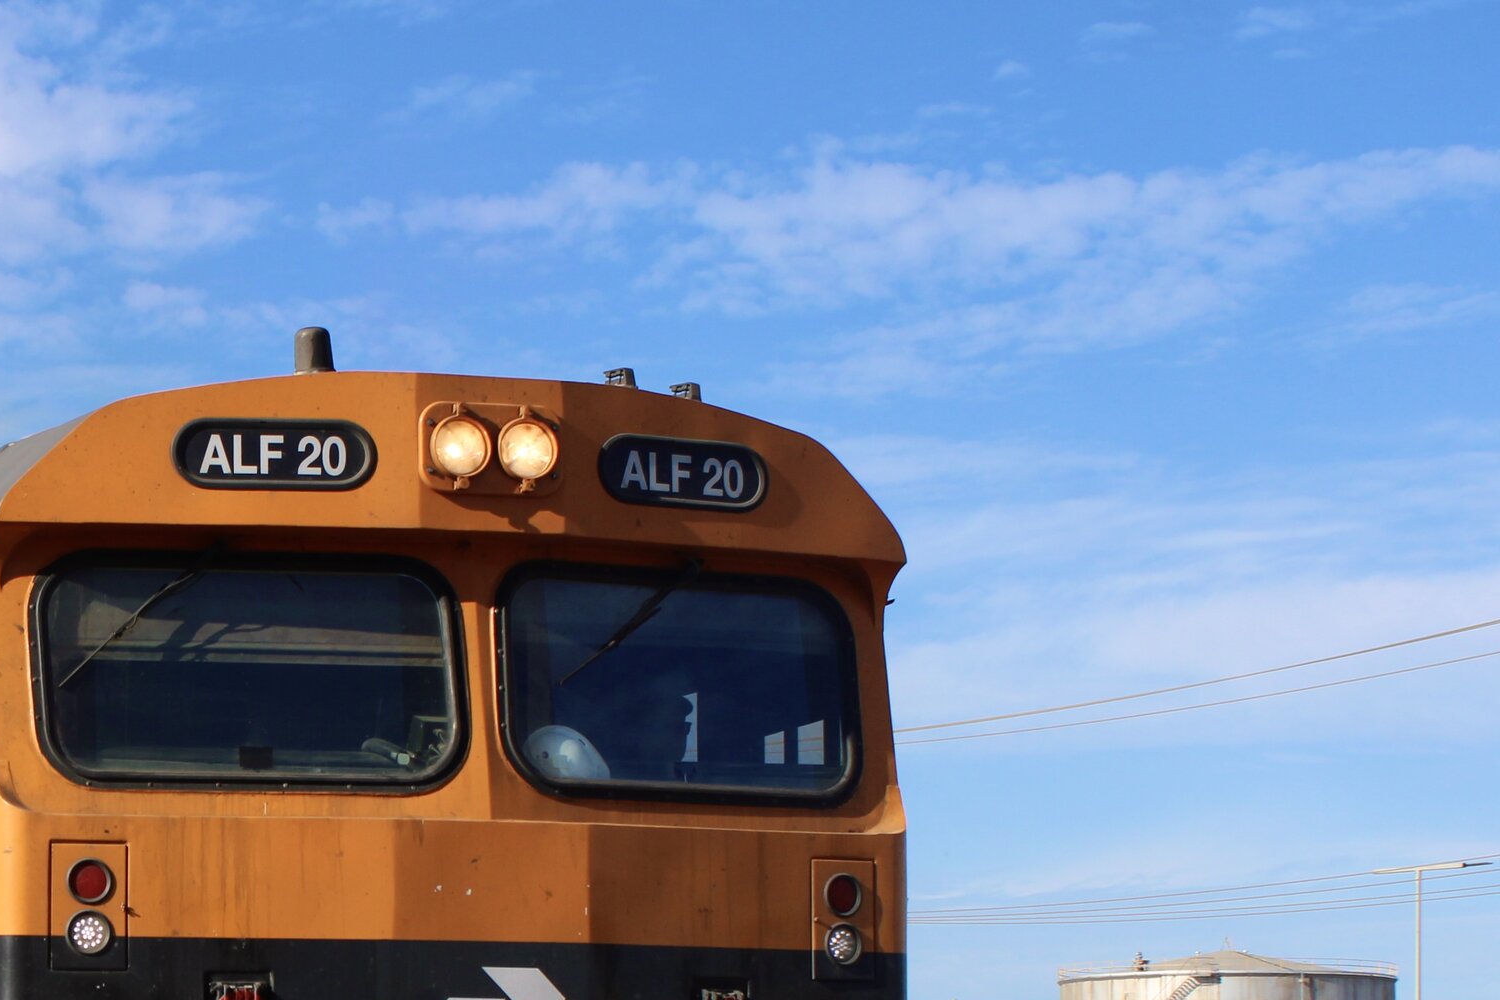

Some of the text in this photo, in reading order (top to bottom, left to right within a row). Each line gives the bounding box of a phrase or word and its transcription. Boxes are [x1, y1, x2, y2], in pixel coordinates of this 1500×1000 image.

[199, 435, 347, 477] ALF 20
[620, 449, 744, 499] ALF 20
